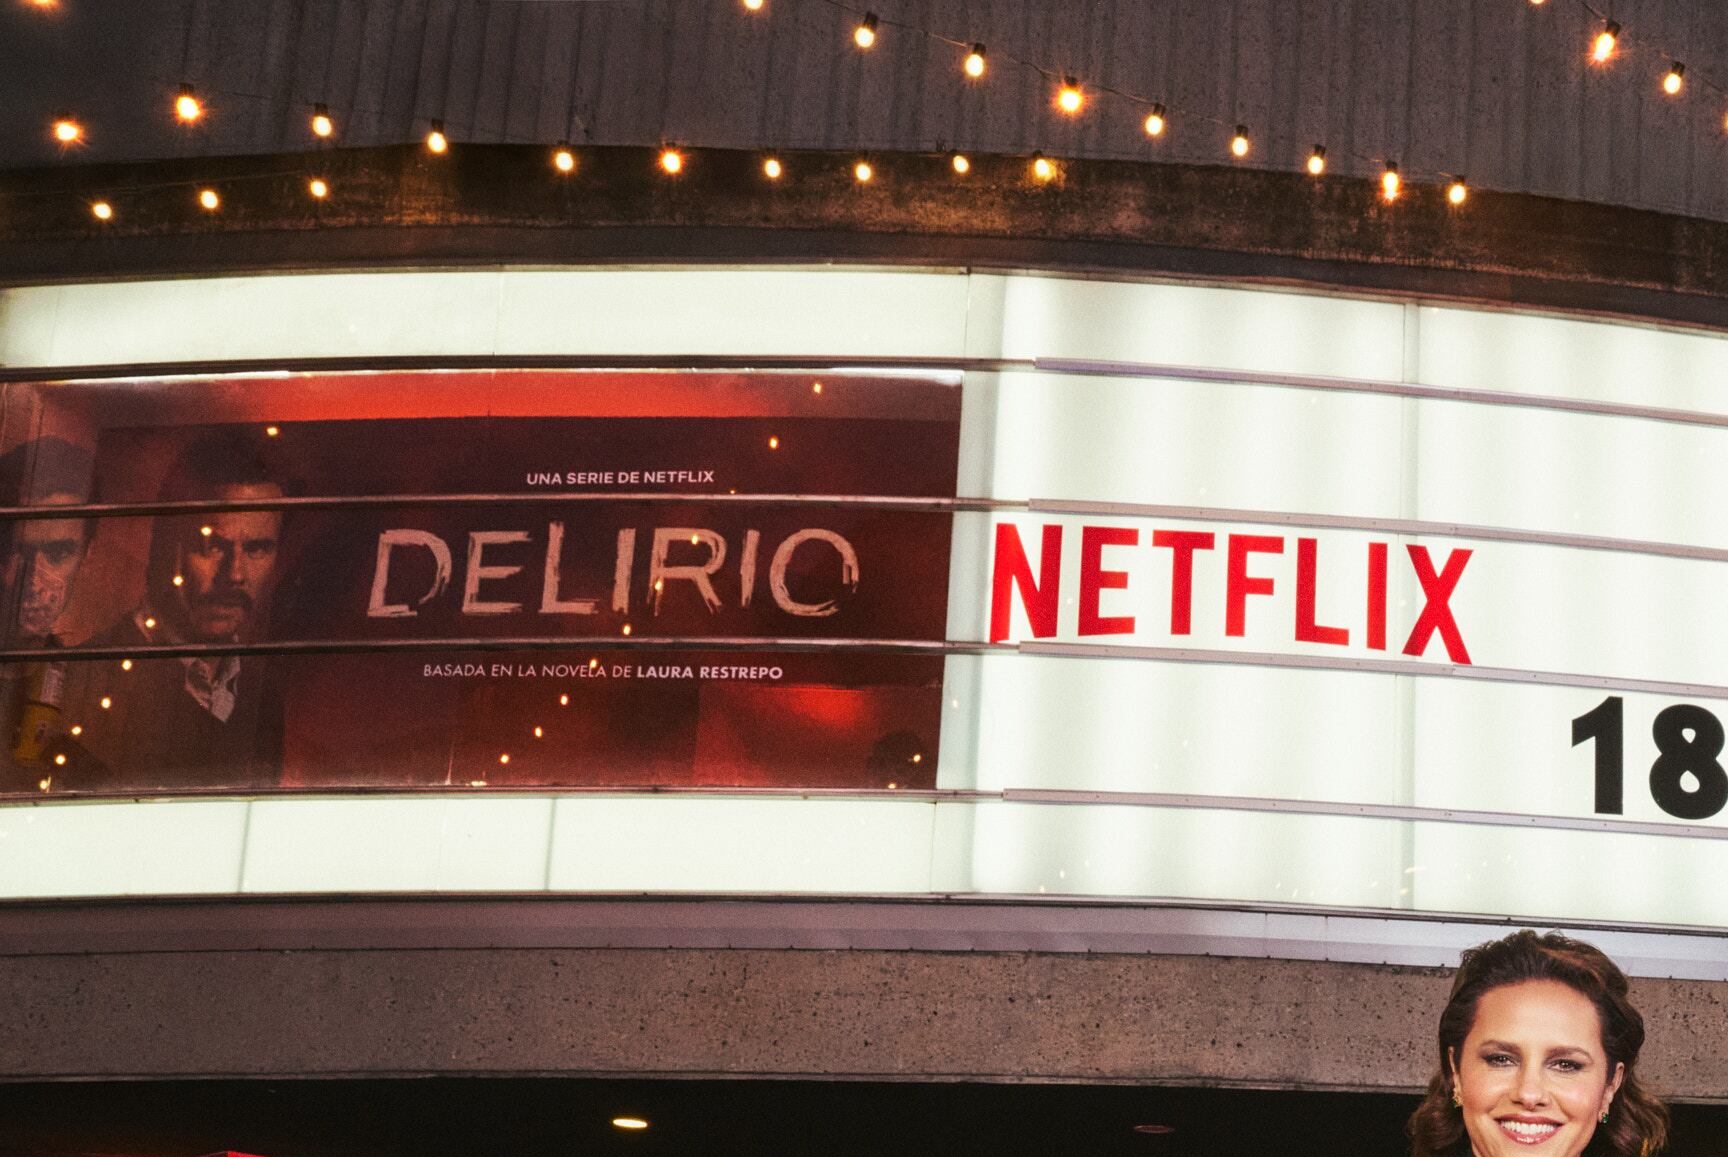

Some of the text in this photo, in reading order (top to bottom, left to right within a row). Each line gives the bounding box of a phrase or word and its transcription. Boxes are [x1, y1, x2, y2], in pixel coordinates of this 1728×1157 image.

[527, 470, 715, 485] UNA SERIE DE NETFLIX
[367, 520, 859, 616] DELIRIO
[989, 523, 1473, 665] NETFLIX
[423, 664, 784, 680] BASADA EN LA NOVELA DE LAURA RESTREPO
